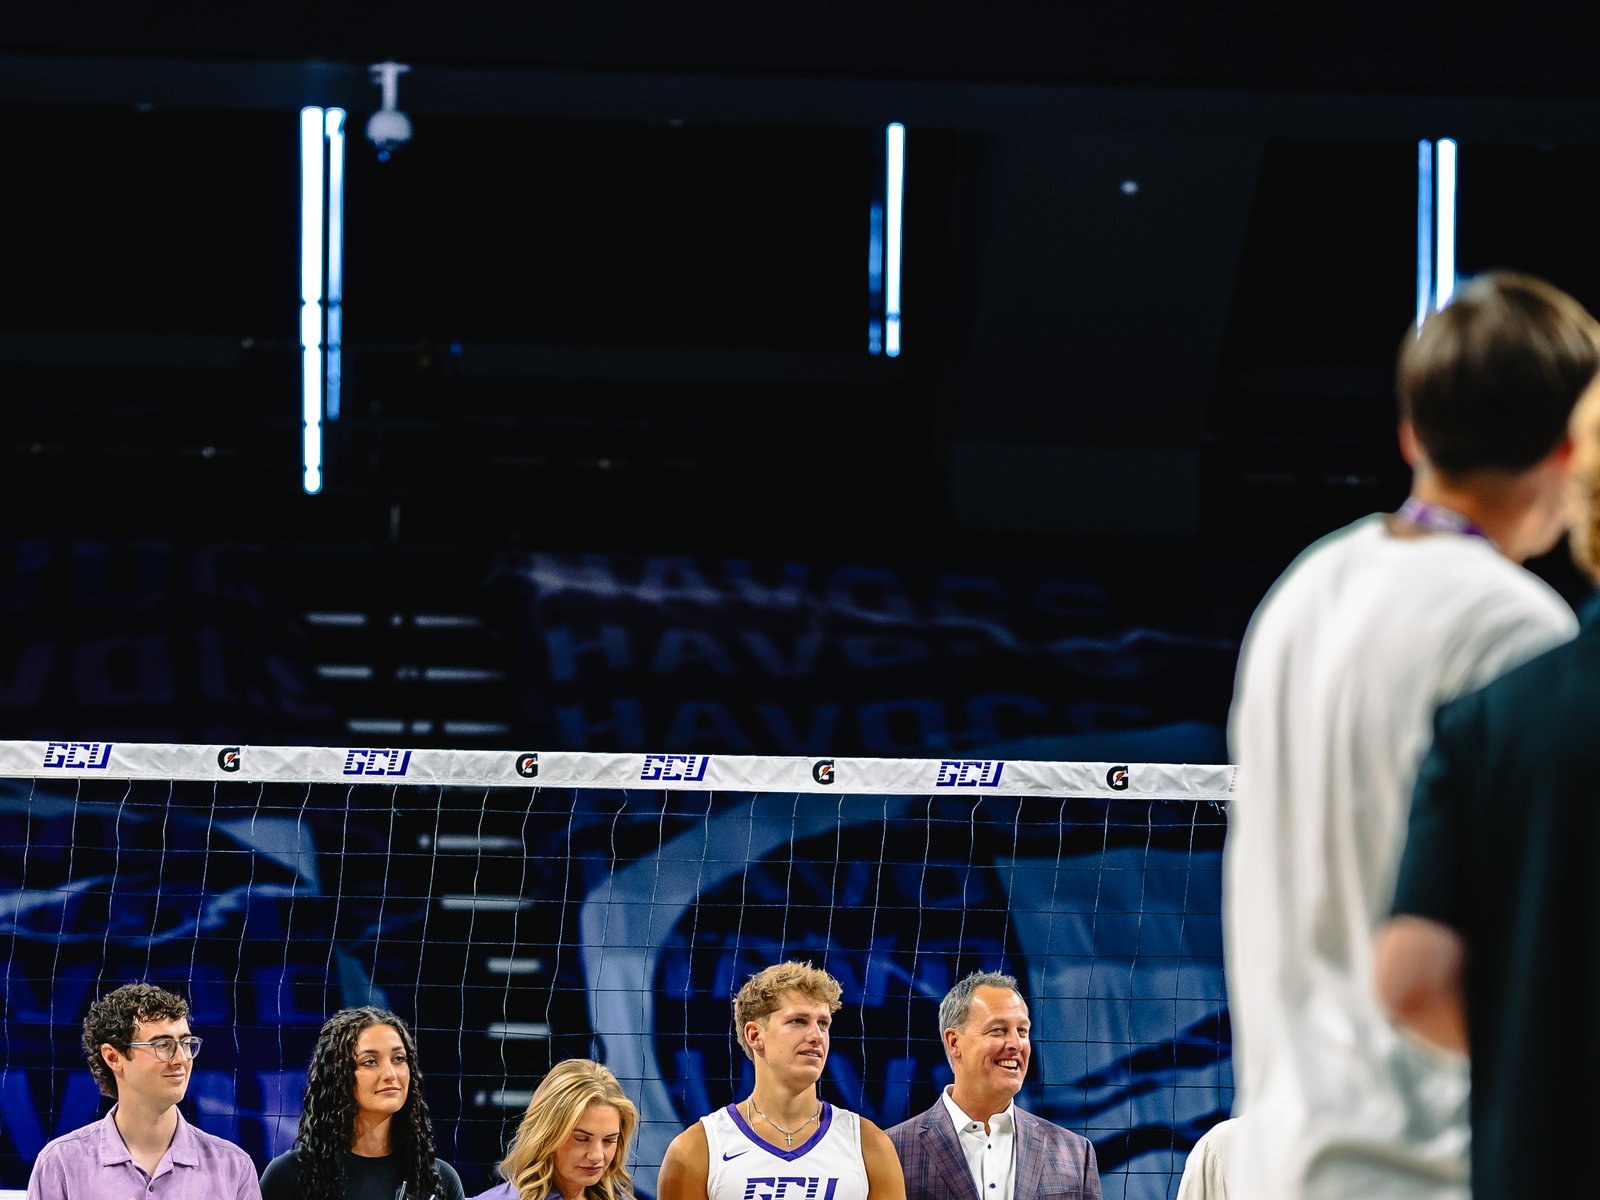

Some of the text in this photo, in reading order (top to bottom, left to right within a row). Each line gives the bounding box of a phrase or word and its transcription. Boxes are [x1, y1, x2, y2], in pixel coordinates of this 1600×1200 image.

[43, 742, 1129, 791] GCU G GCU G GCU G GCU G
